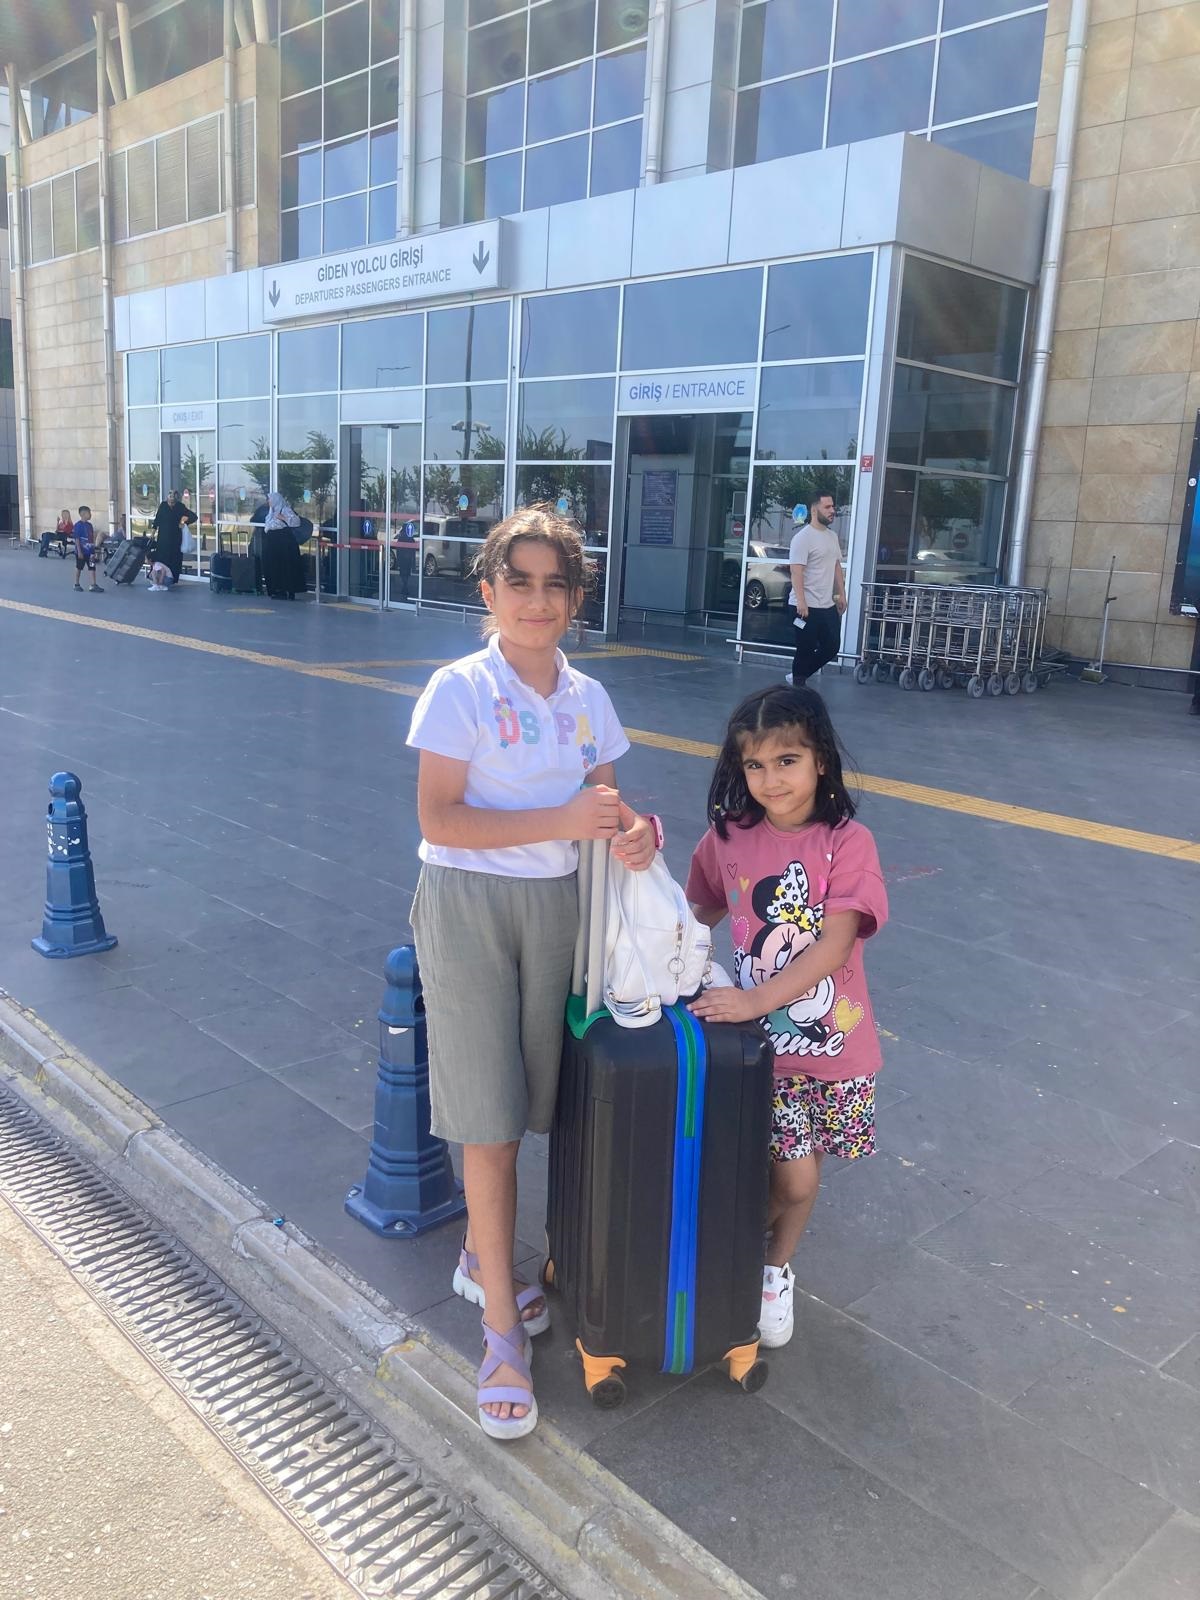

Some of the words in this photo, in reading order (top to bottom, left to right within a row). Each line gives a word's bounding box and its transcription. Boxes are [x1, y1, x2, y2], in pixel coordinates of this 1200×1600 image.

[318, 263, 348, 282] GİDEN
[351, 256, 387, 276] YOLCU
[390, 244, 423, 268] GİRİŞİ
[295, 286, 344, 305] DEPARTURES
[346, 278, 400, 298] PASSENGERS
[403, 268, 451, 287] ENTRANCE
[629, 382, 662, 402] GİRİŞ
[672, 380, 745, 399] ENTRANCE
